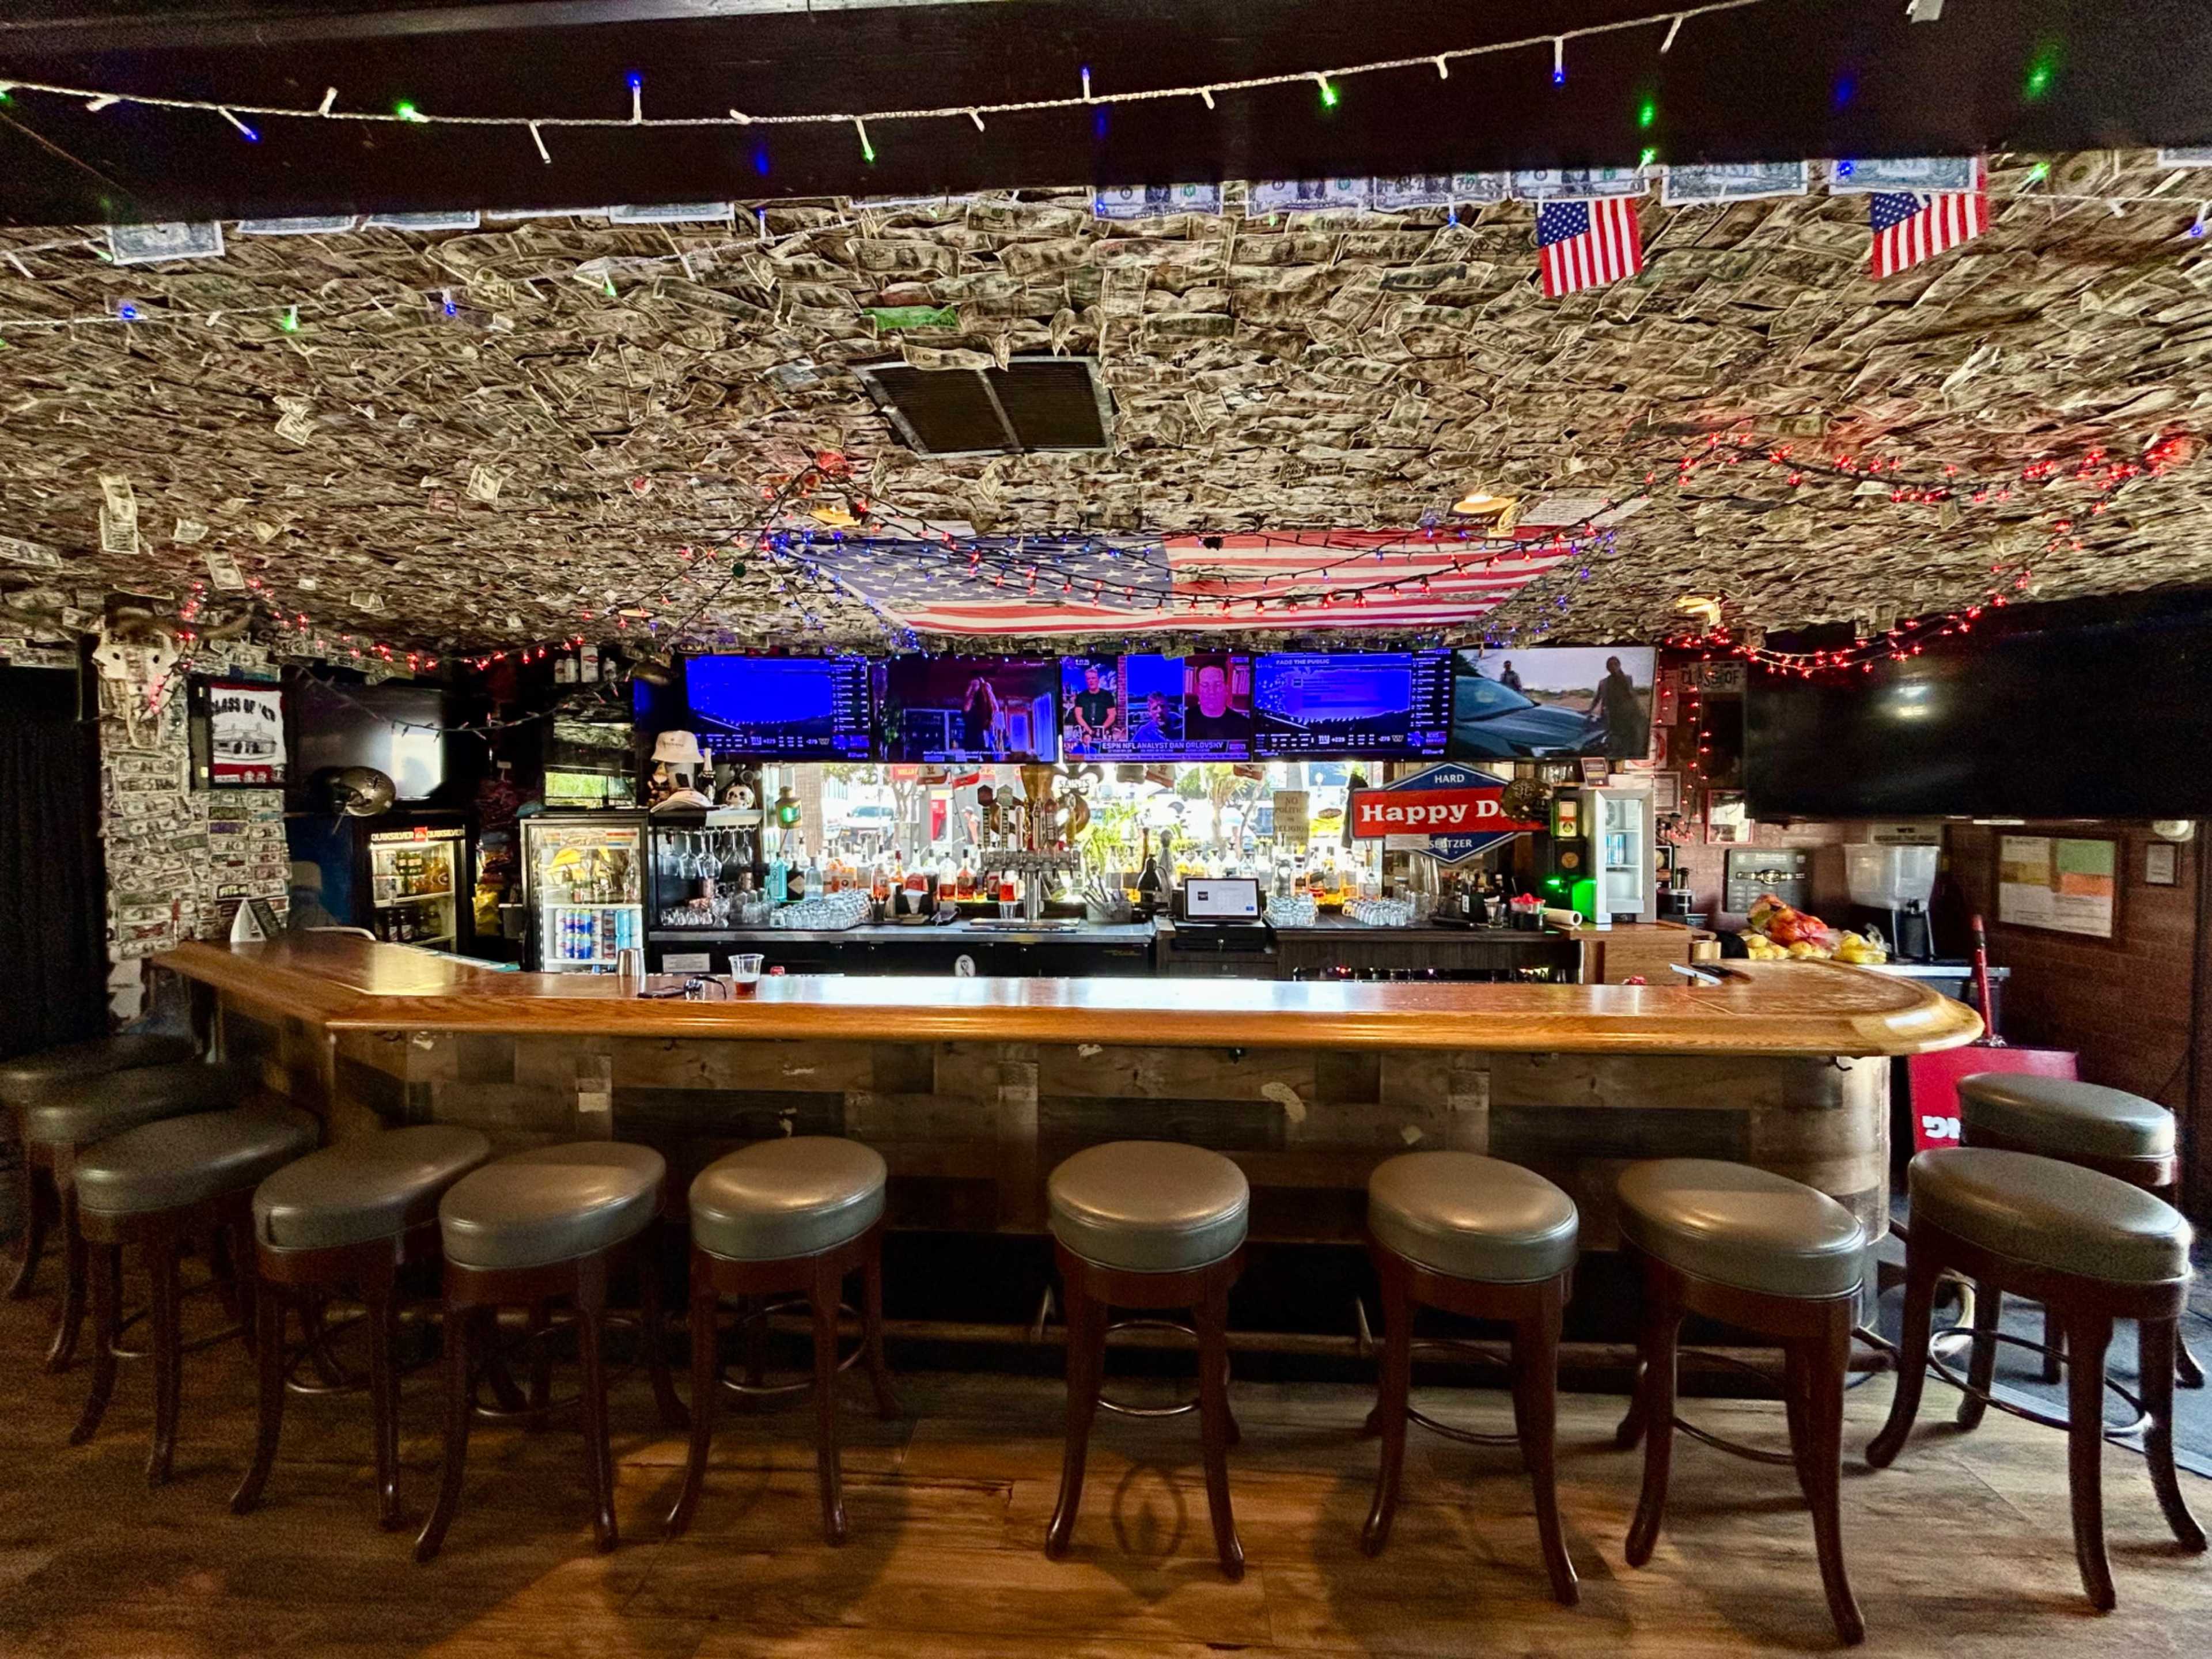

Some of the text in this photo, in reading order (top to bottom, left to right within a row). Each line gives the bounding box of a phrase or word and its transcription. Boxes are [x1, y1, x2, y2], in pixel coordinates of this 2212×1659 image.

[1725, 669, 1740, 684] OF
[244, 699, 256, 714] OF
[1169, 741, 1184, 749] DAN
[1058, 778, 1090, 789] SAINTS
[1434, 774, 1465, 784] HARD
[1285, 797, 1299, 805] NO
[1360, 803, 1469, 825] Happy
